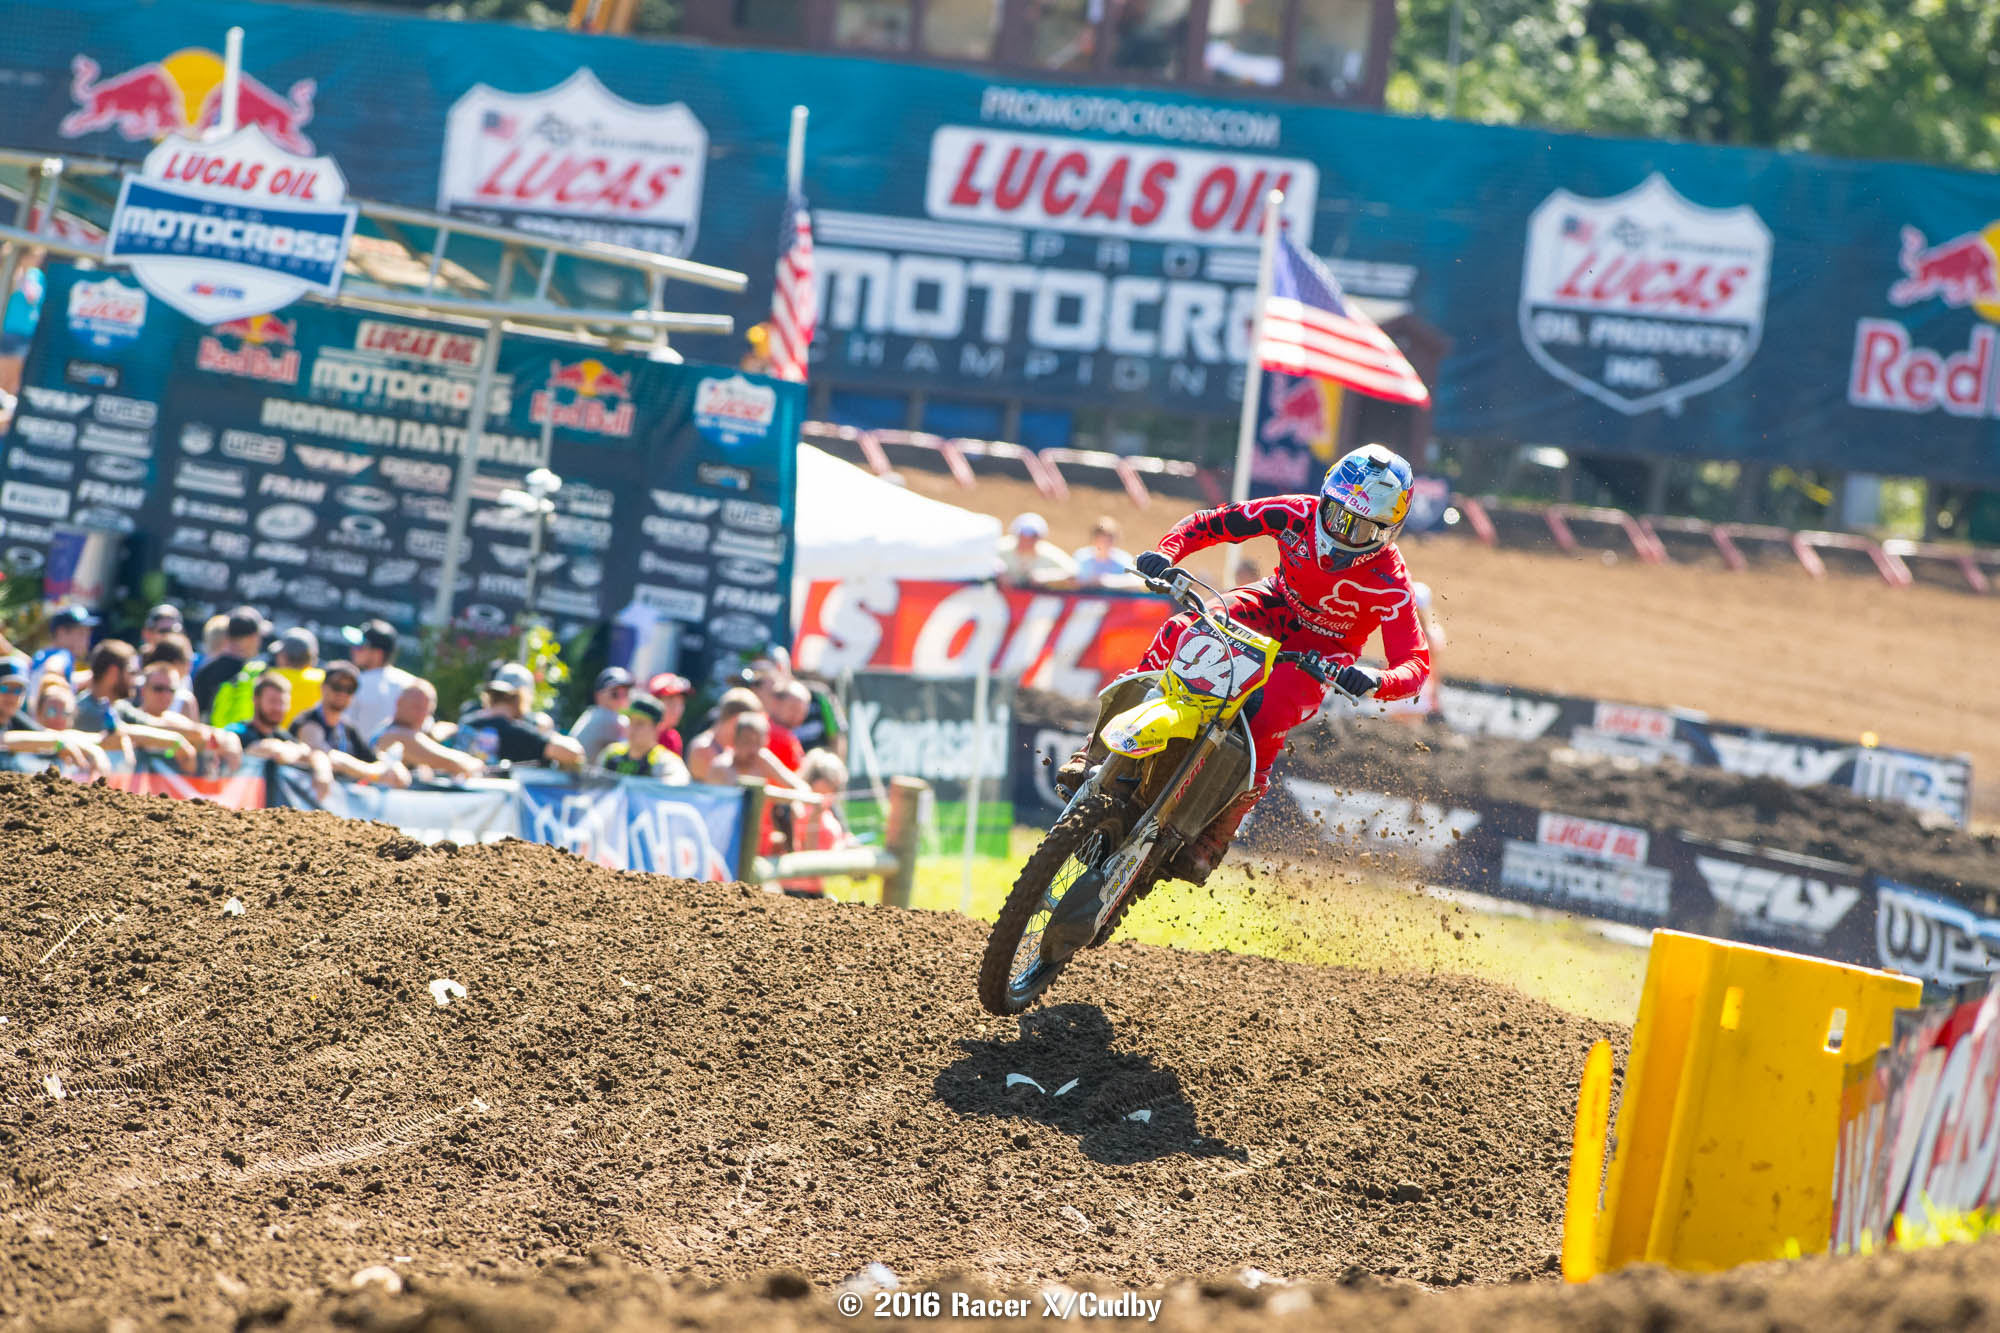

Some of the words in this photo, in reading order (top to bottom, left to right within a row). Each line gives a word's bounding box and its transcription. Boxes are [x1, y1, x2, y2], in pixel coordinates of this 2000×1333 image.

[163, 154, 263, 191] LUCAS
[268, 172, 319, 199] OIL
[475, 149, 685, 211] LUCAS
[948, 140, 1178, 226] LUCAS
[1189, 165, 1293, 236] OIL
[119, 205, 339, 261] MOTOCROSS
[1030, 231, 1200, 279] PRO
[812, 246, 1258, 364] MOTOCRO
[1554, 249, 1750, 315] LUCAS
[197, 337, 245, 374] Red
[245, 340, 300, 384] Bull
[362, 325, 437, 358] LUCAS
[439, 337, 475, 365] OIL
[1850, 318, 1992, 414] Red
[311, 357, 512, 415] MOTOCROS
[260, 397, 398, 449] IRONMAN
[583, 402, 635, 437] Bull
[1325, 487, 1350, 502] Red
[1348, 497, 1371, 515] Bull
[912, 582, 1109, 699] OIL
[1233, 641, 1248, 652] OIL
[1313, 615, 1354, 631] Eagle
[1170, 635, 1262, 699] 94
[1695, 855, 1862, 933] FLY
